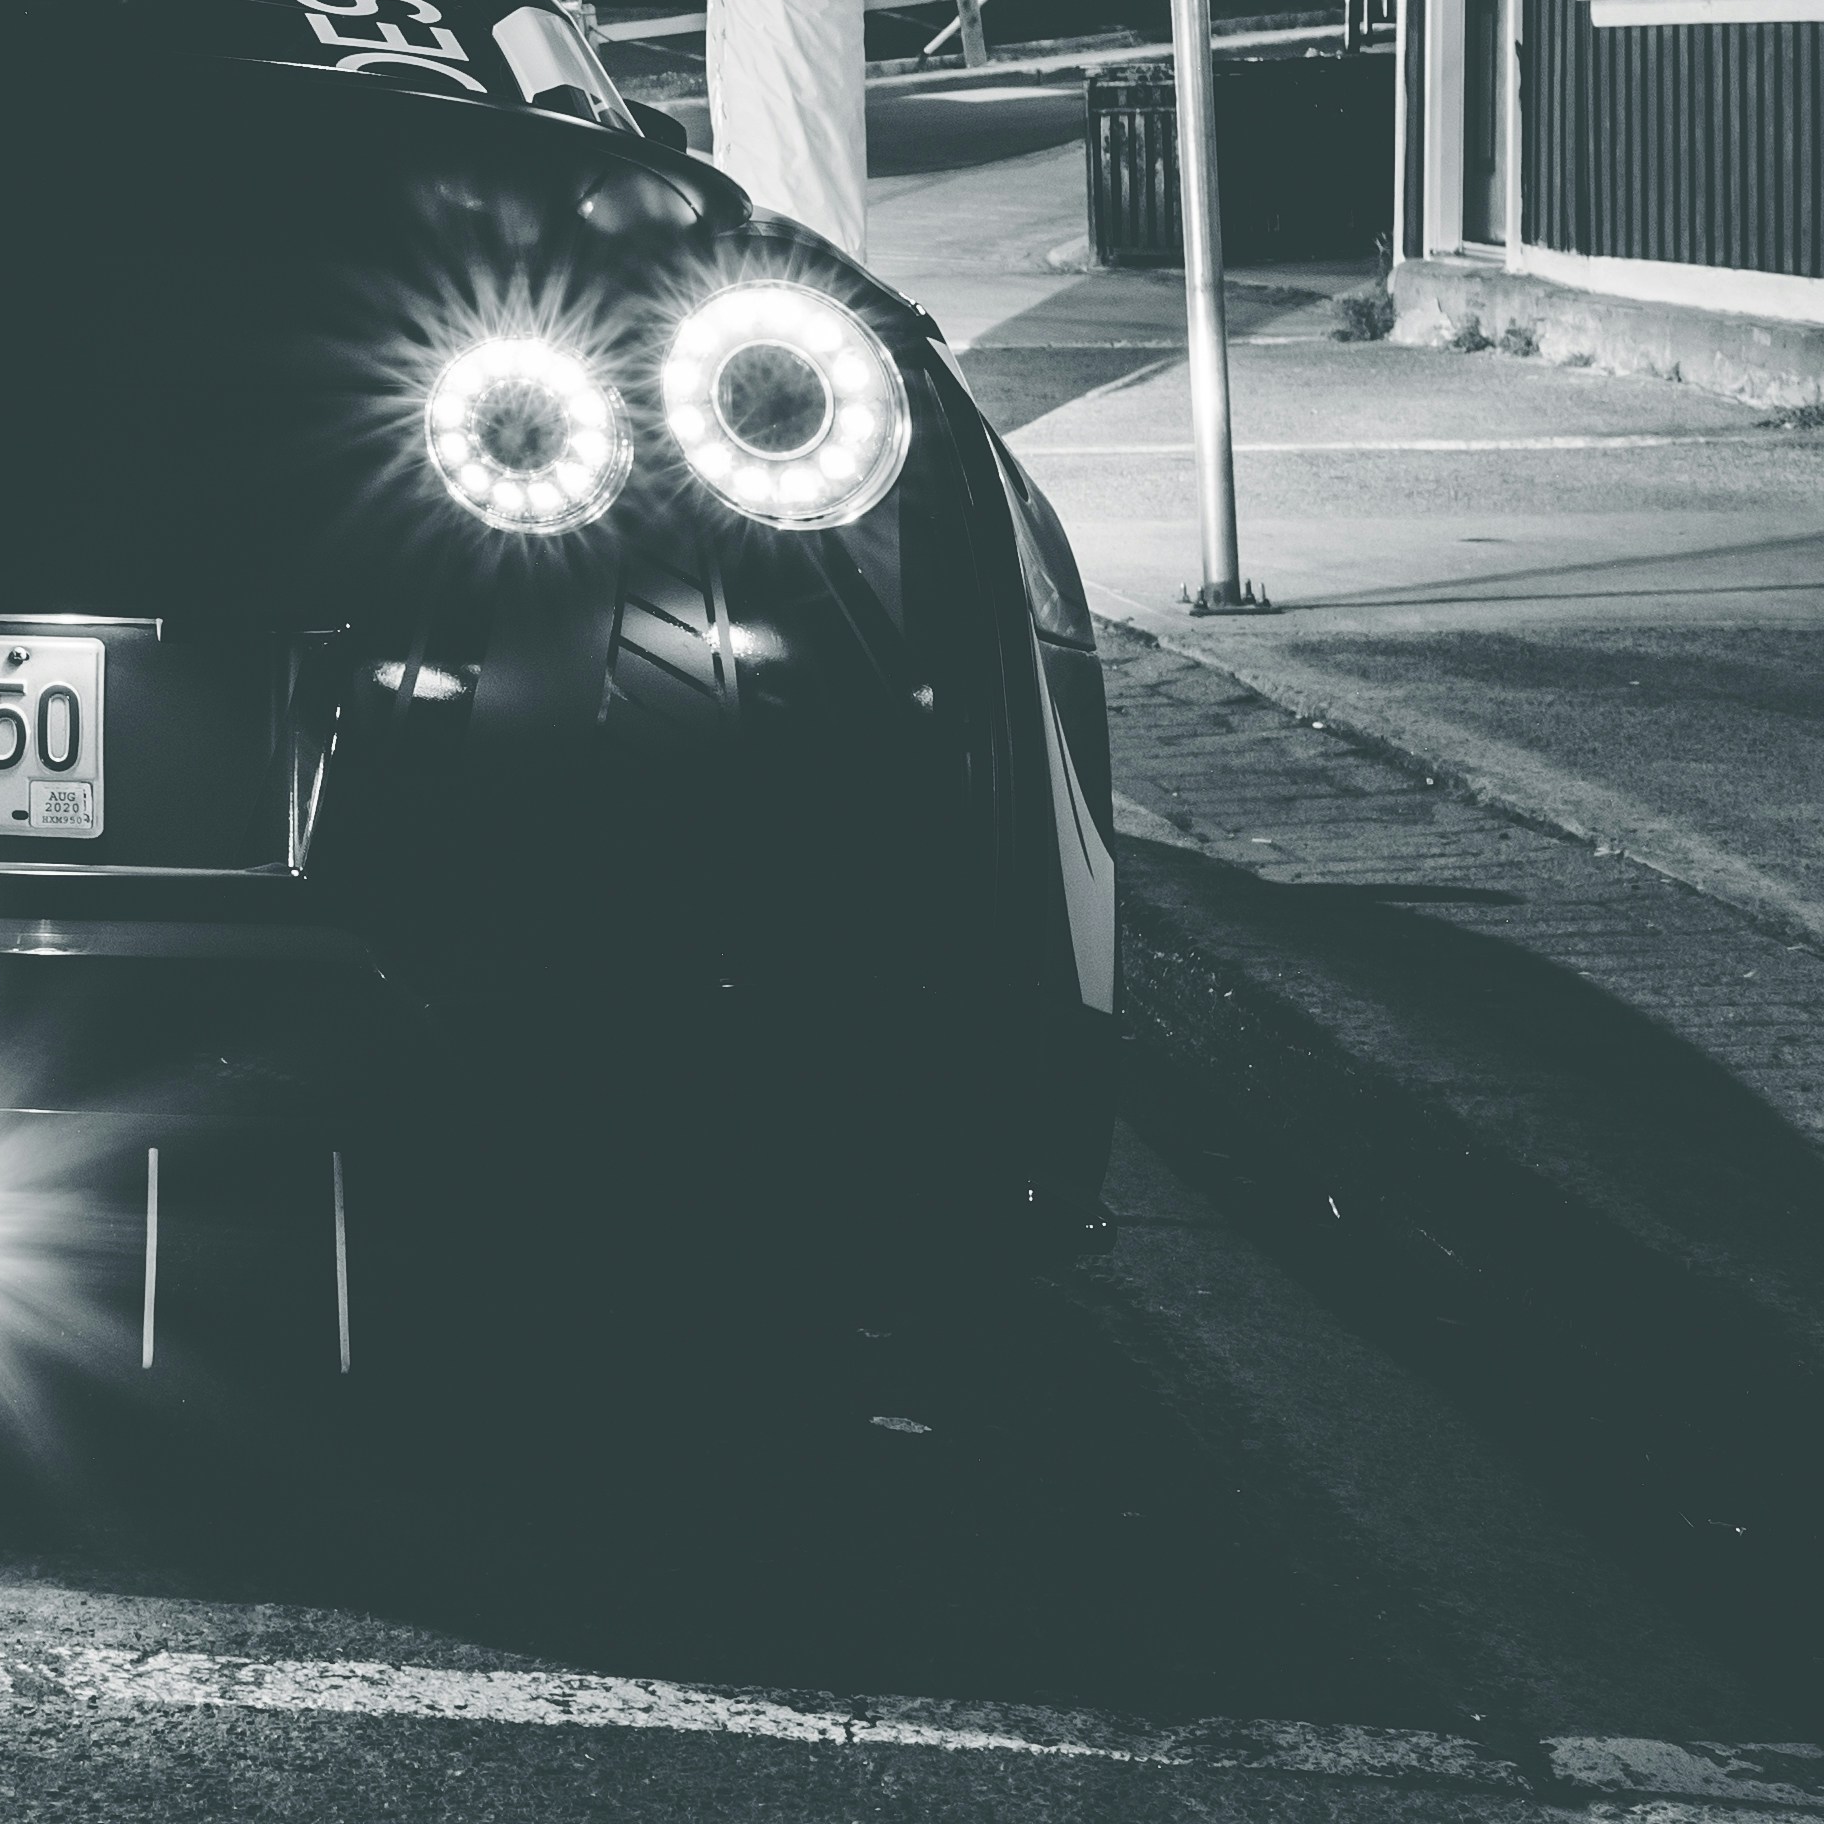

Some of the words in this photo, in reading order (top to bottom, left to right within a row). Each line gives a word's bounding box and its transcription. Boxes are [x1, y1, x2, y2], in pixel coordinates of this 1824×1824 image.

[49, 792, 76, 801] AUG
[45, 803, 79, 813] 2020
[42, 816, 82, 824] HXM950
